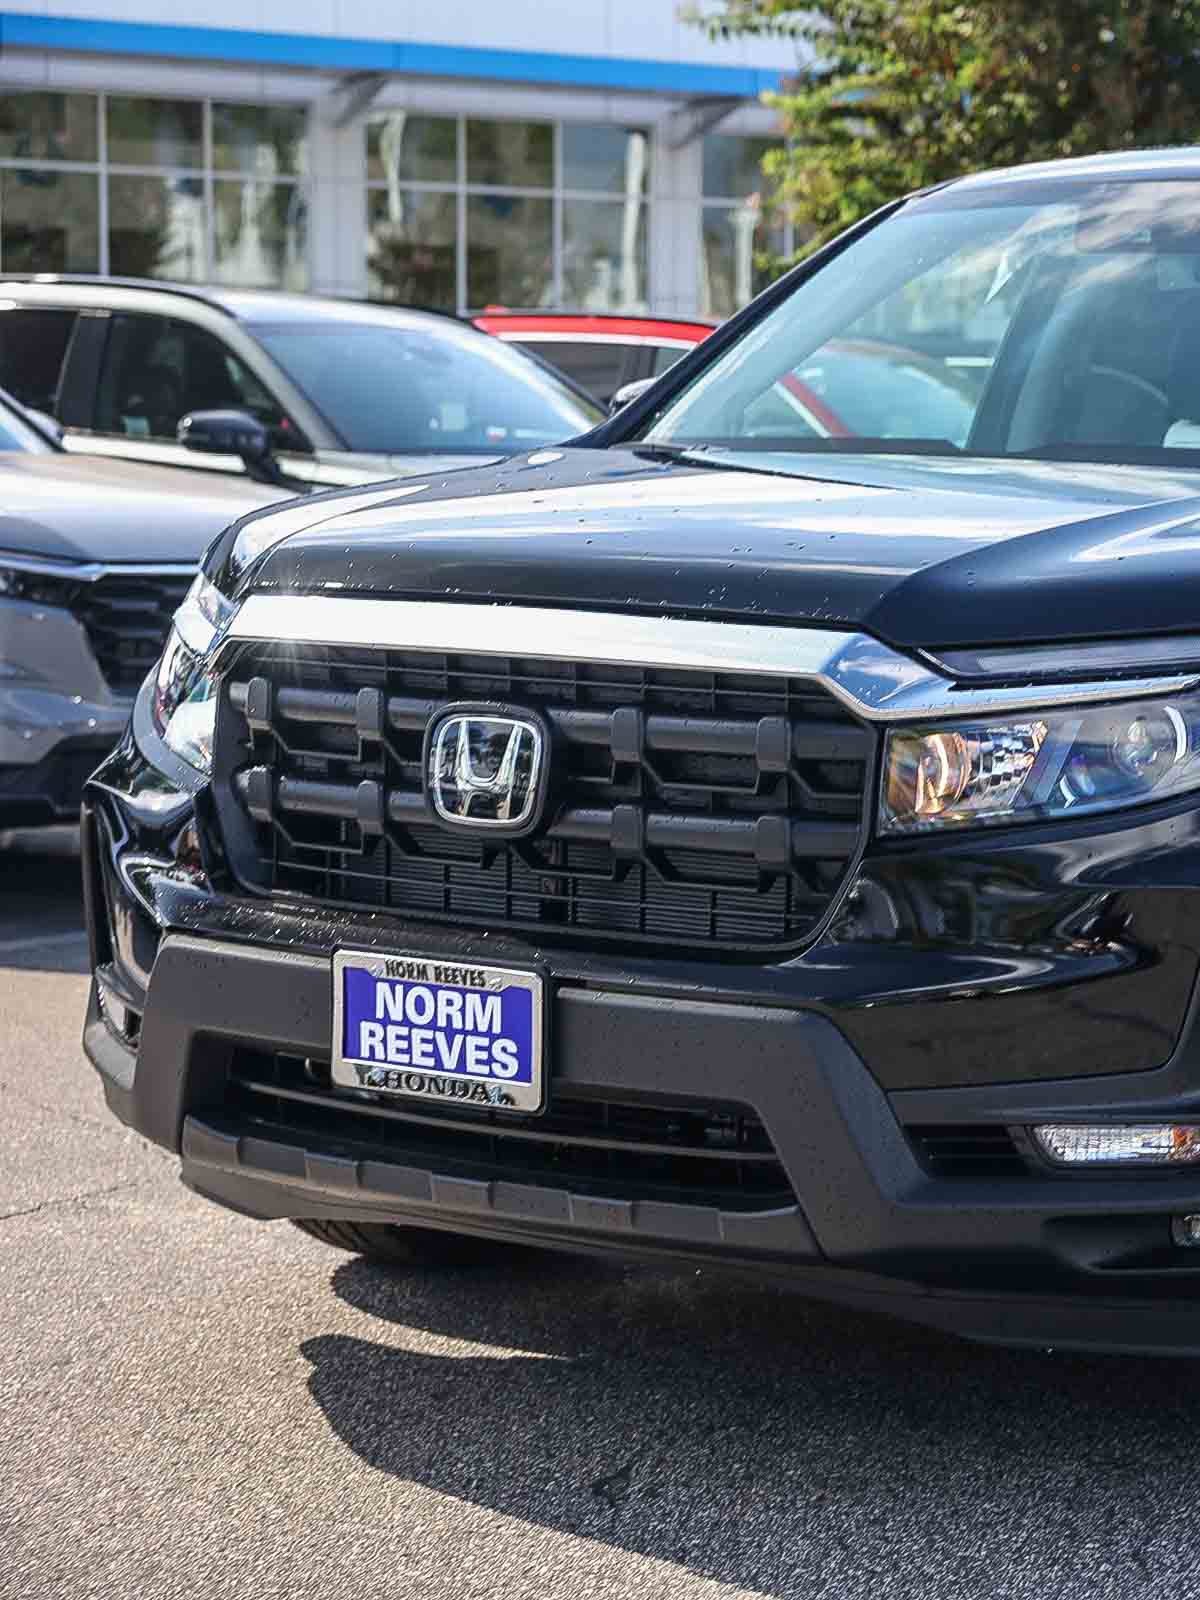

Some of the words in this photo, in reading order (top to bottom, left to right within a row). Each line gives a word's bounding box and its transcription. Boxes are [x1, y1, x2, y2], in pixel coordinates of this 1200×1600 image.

[384, 959, 429, 981] NORM
[433, 965, 486, 987] REEVES
[375, 981, 502, 1034] NORM
[359, 1020, 519, 1078] REEVES
